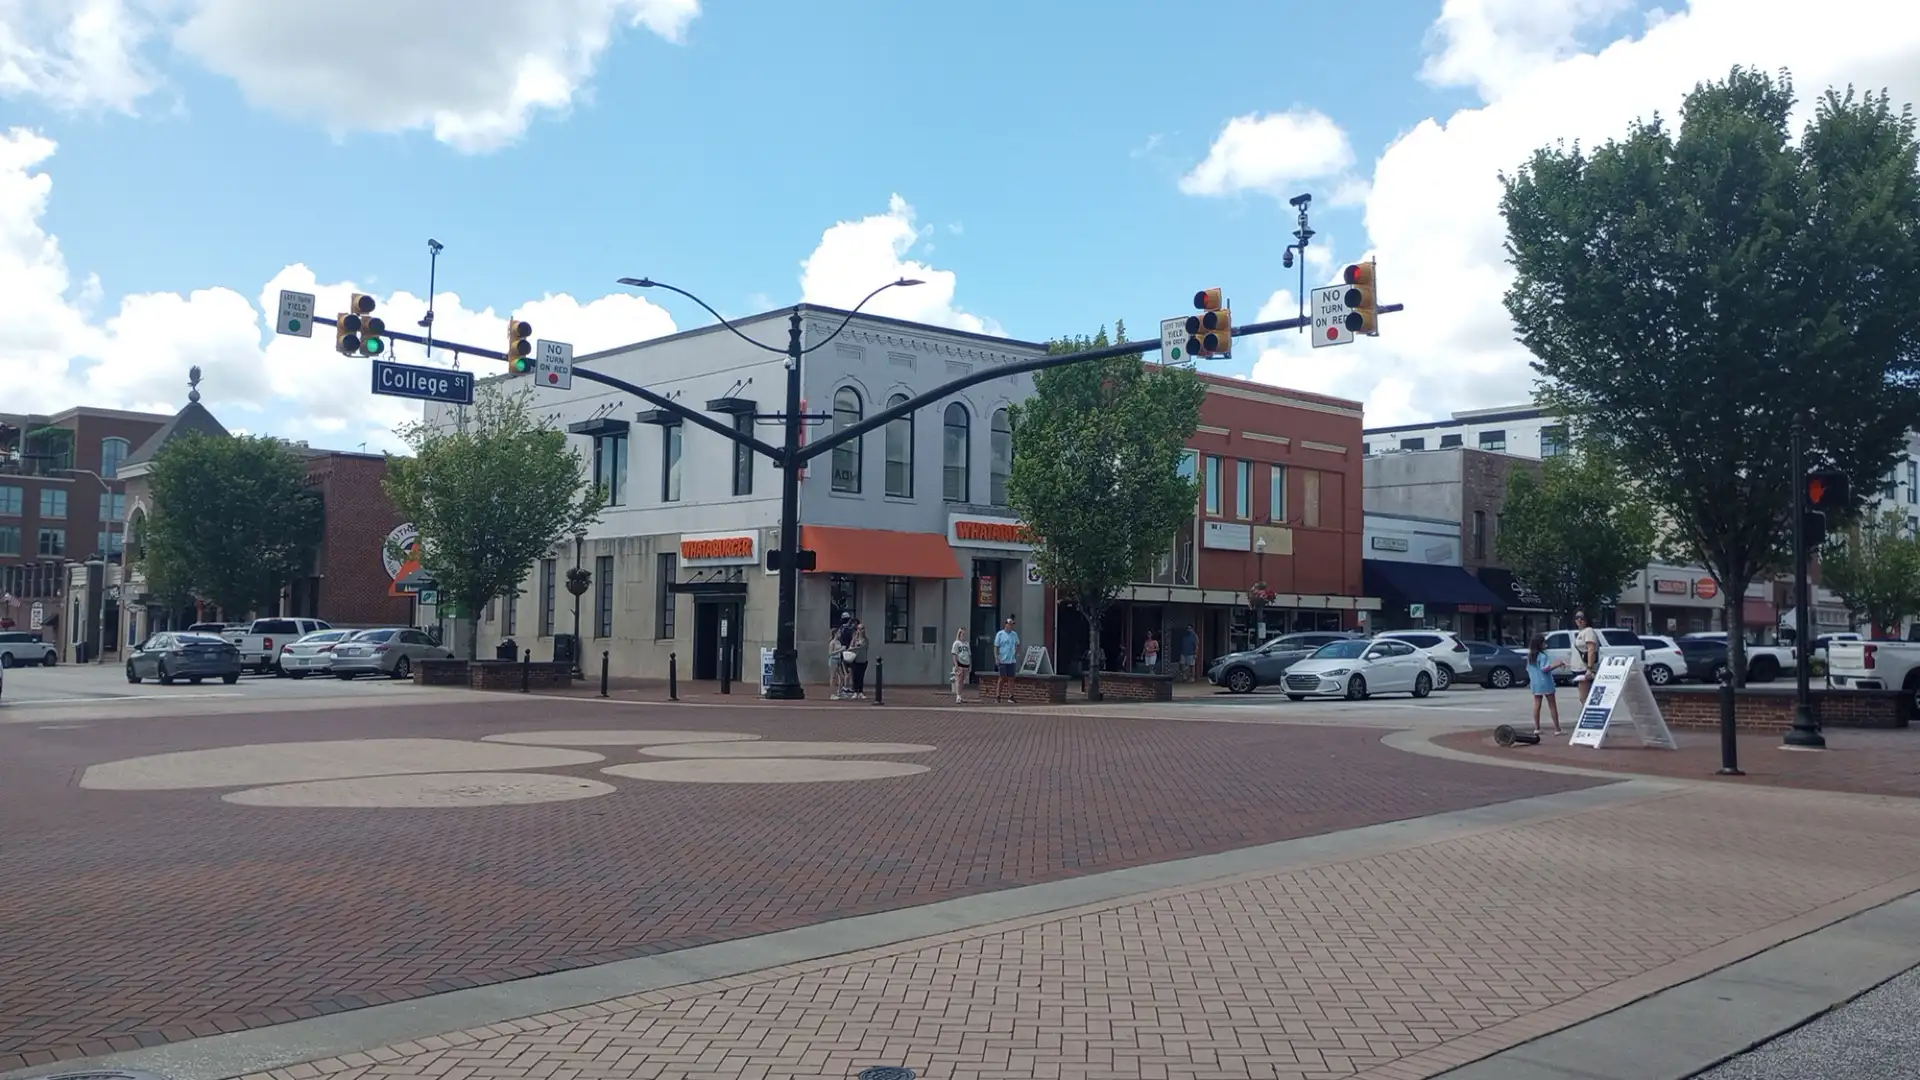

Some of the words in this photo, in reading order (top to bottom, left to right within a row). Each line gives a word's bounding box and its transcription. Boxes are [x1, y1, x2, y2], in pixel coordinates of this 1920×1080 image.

[1323, 290, 1340, 303] NO
[288, 302, 307, 312] YIELD
[1321, 304, 1343, 315] TURN
[1316, 317, 1327, 327] ON
[1332, 315, 1347, 325] RED
[1168, 329, 1183, 339] YIELD
[548, 344, 562, 355] NO
[546, 355, 564, 364] TURN
[540, 363, 550, 371] ON
[554, 365, 568, 374] RED
[383, 368, 449, 395] College
[454, 377, 464, 387] St
[681, 537, 753, 559] WHATABURGER
